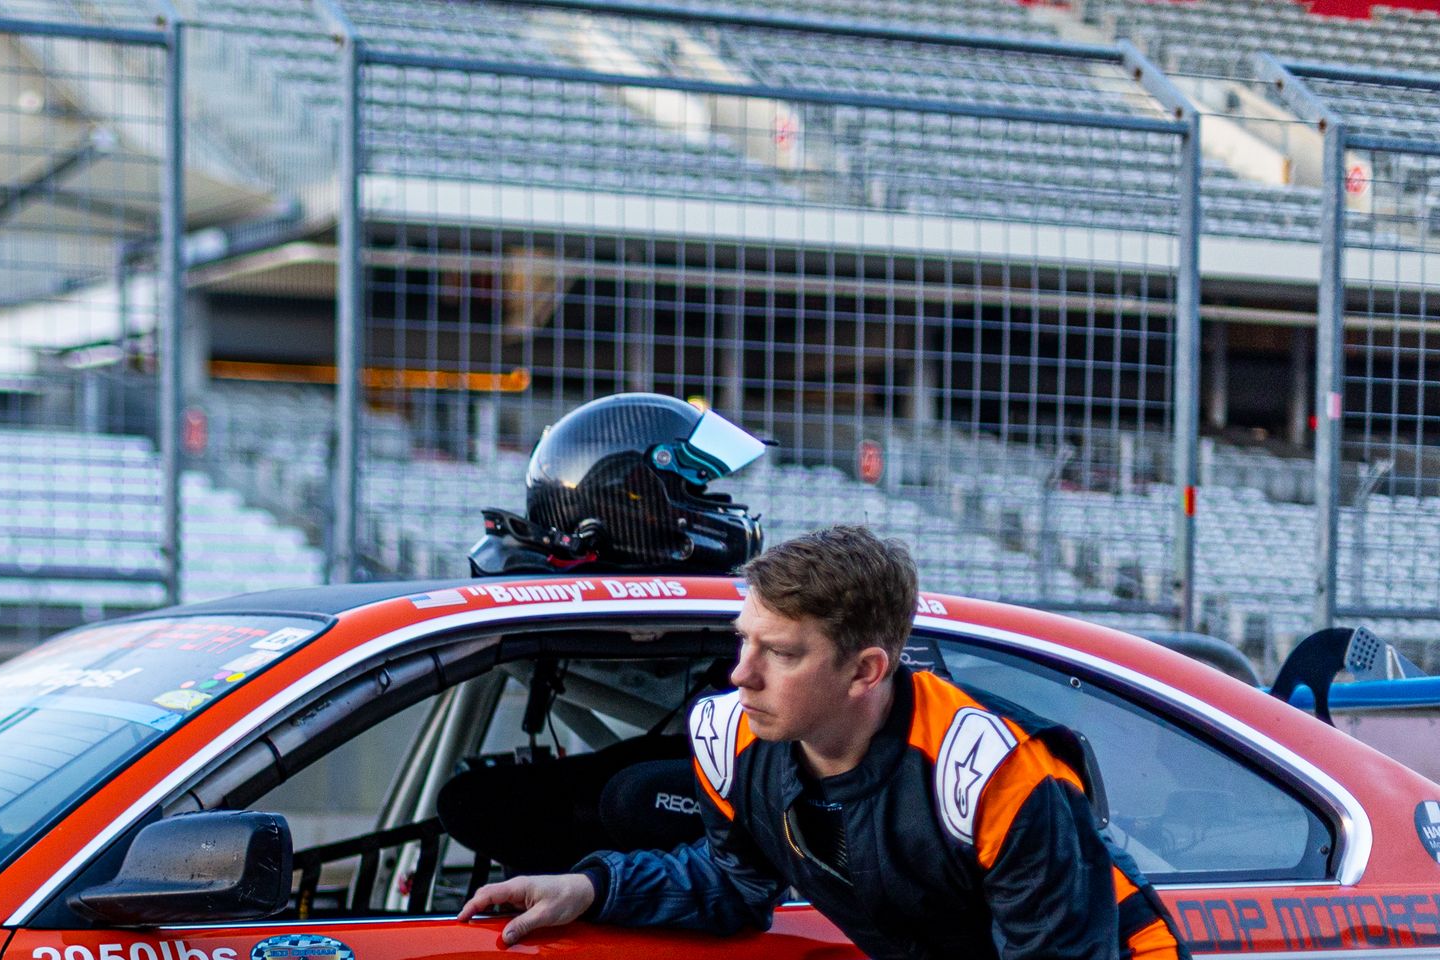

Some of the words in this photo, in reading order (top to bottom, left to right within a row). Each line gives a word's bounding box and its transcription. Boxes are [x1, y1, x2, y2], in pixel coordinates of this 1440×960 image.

[467, 580, 595, 603] "Bunny"
[602, 579, 687, 599] Davis
[655, 792, 702, 815] RECA
[1272, 893, 1440, 949] MOTORS
